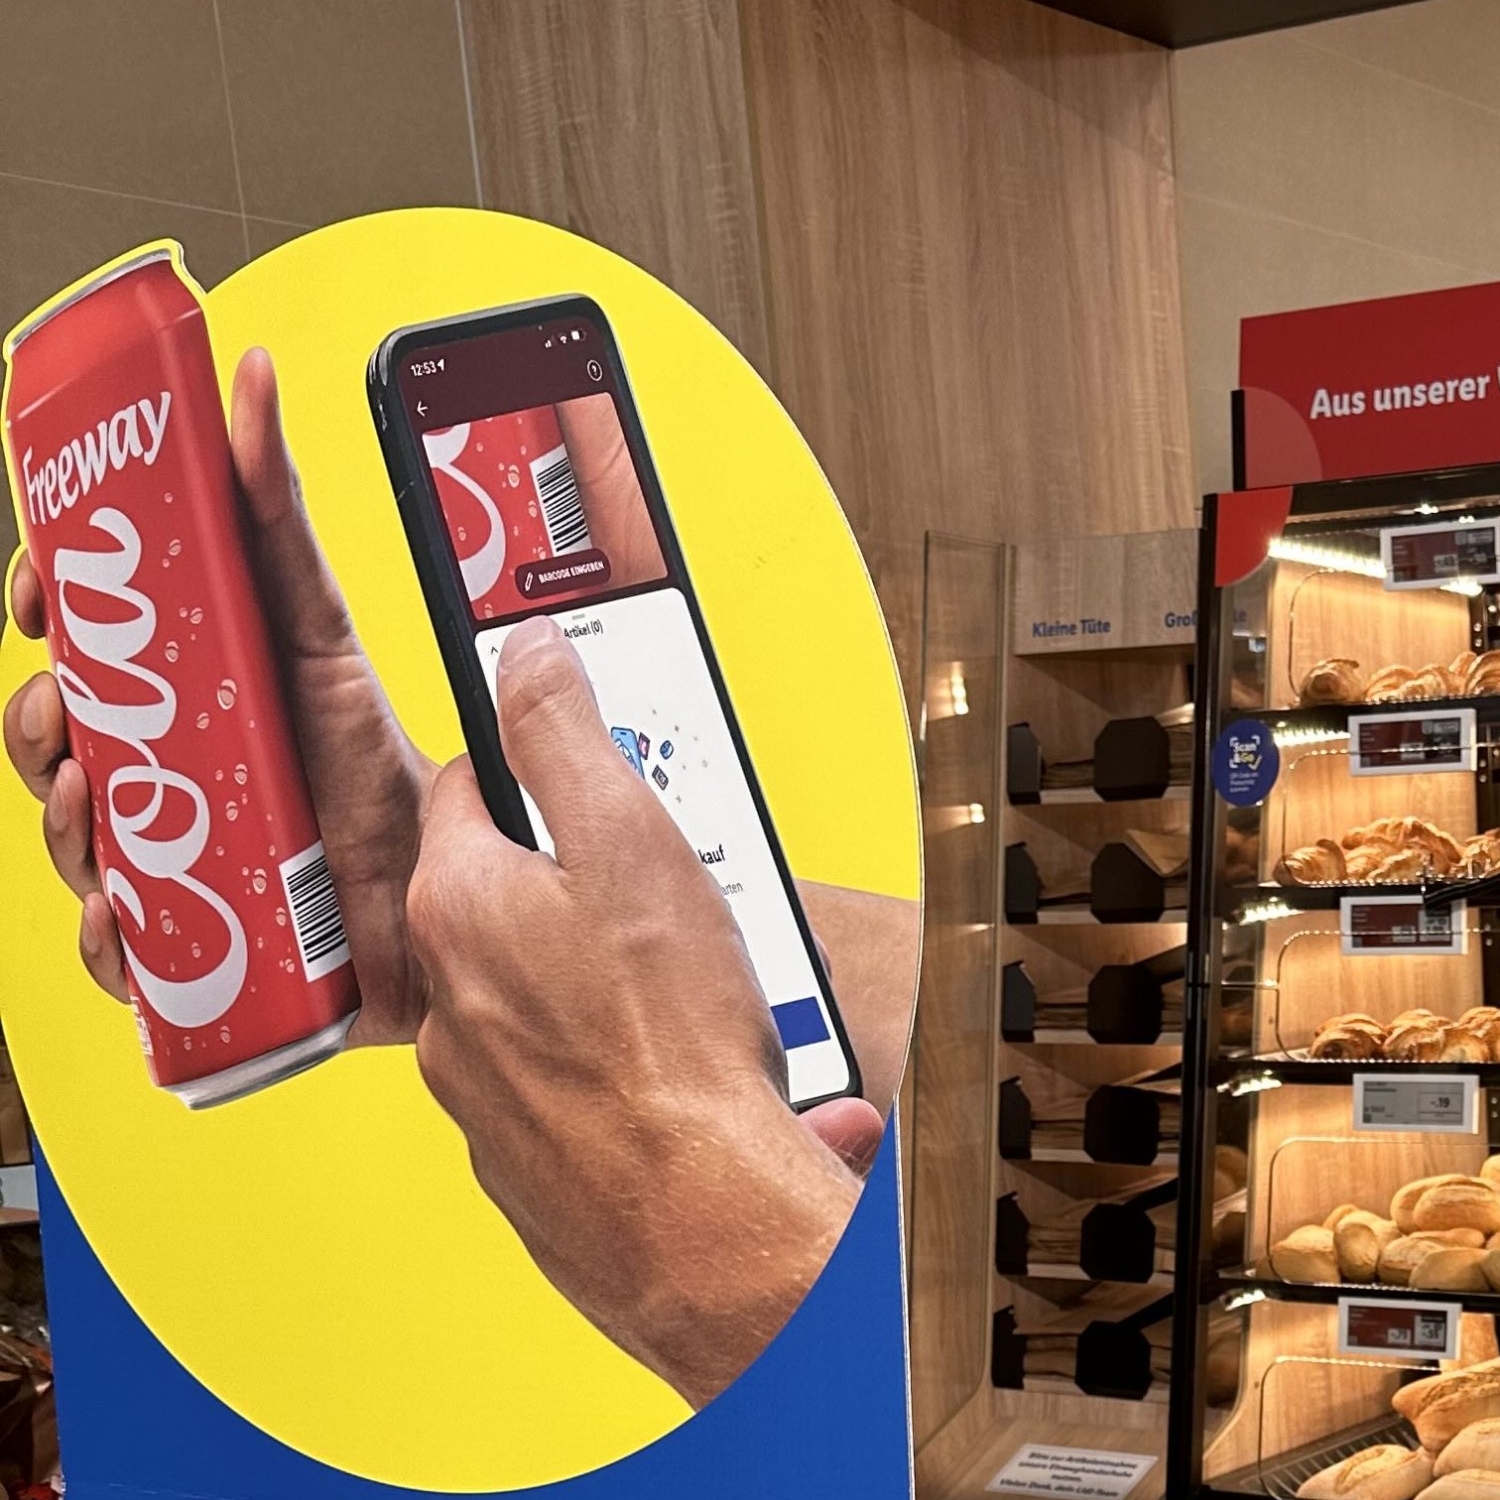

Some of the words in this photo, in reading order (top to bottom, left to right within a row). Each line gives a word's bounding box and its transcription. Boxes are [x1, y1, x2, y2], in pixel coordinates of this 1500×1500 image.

[411, 361, 437, 377] 12:53
[1310, 388, 1366, 419] Aus
[1373, 373, 1490, 412] unserer
[22, 391, 172, 526] Freeway
[538, 564, 571, 583] BARCODE
[563, 623, 592, 639] Artikel
[1032, 621, 1077, 638] Kleine
[1080, 618, 1111, 634] Tüte
[53, 507, 248, 1027] Cola
[698, 844, 725, 864] kauf
[720, 881, 744, 895] arten
